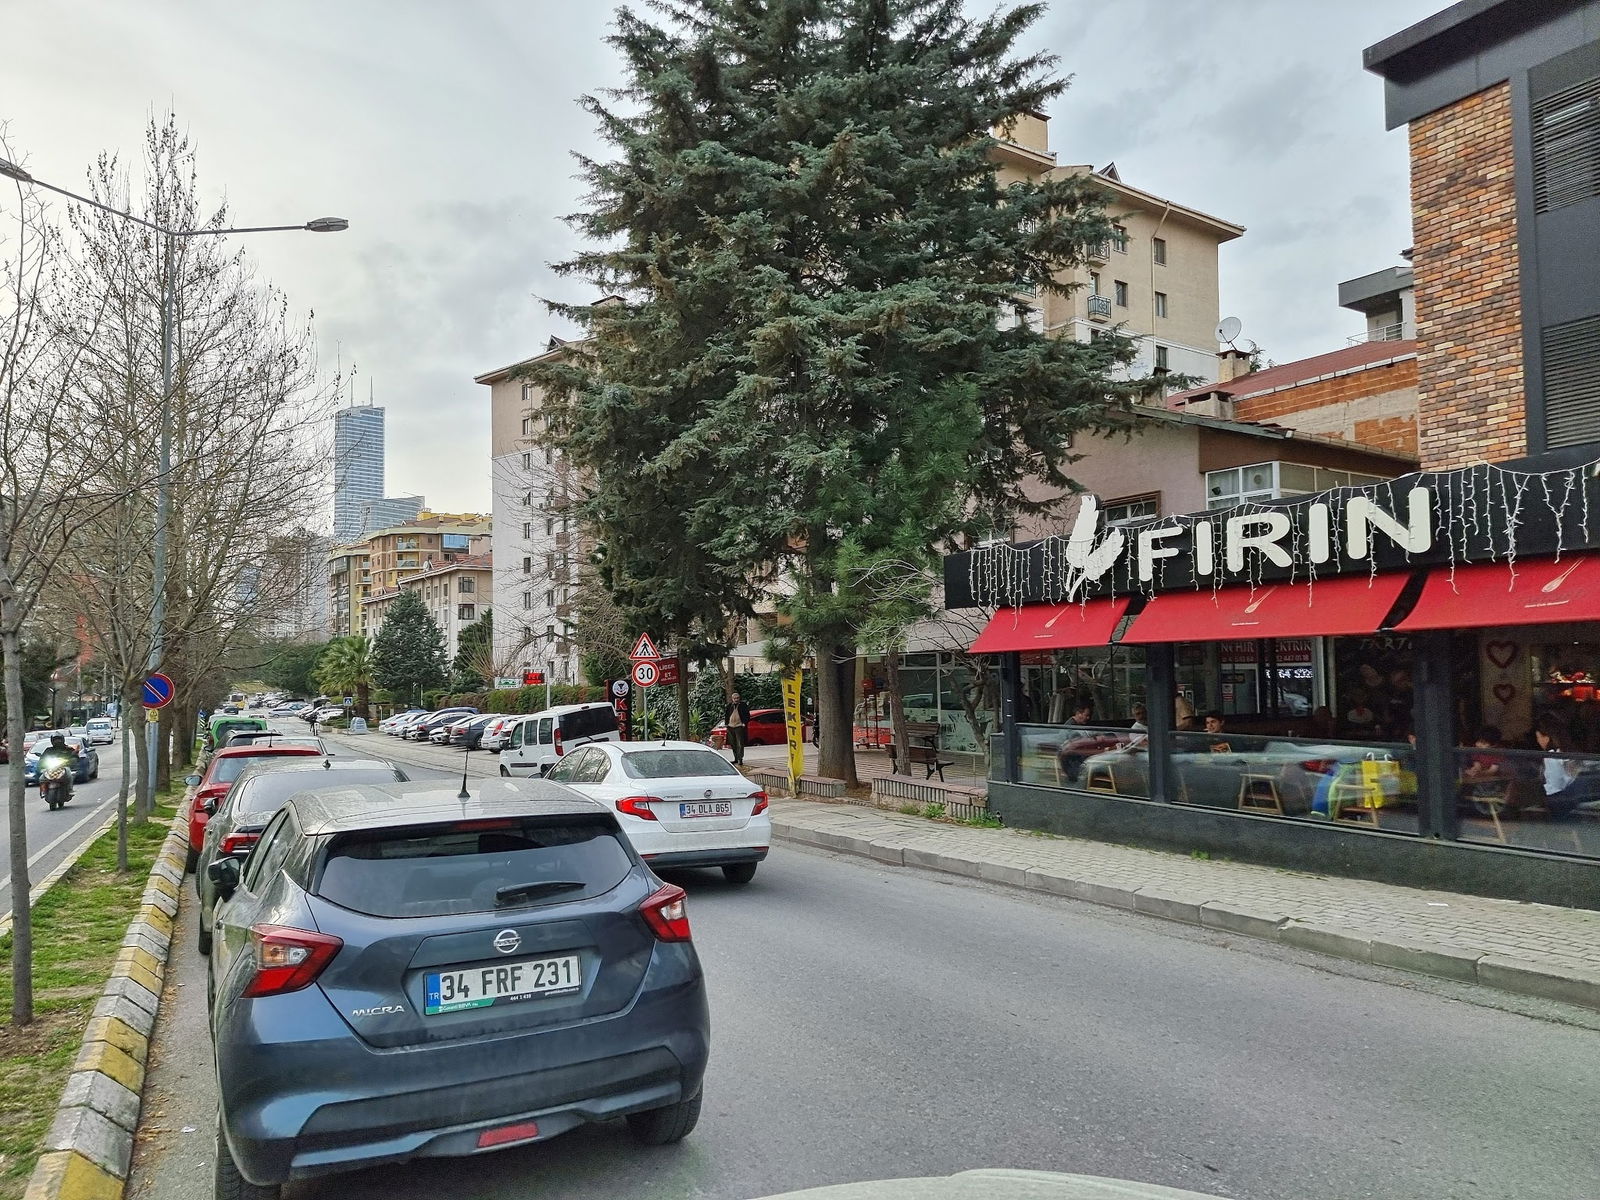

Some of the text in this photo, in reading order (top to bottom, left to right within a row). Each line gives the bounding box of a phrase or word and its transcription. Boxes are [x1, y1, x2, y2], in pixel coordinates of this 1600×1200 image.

[1137, 486, 1431, 582] FIRIN
[638, 667, 653, 680] 30
[686, 805, 696, 815] 34
[698, 804, 713, 814] DLA
[441, 959, 571, 1001] 34 FRF 231
[428, 992, 440, 1001] TR
[352, 1004, 405, 1016] MICRA
